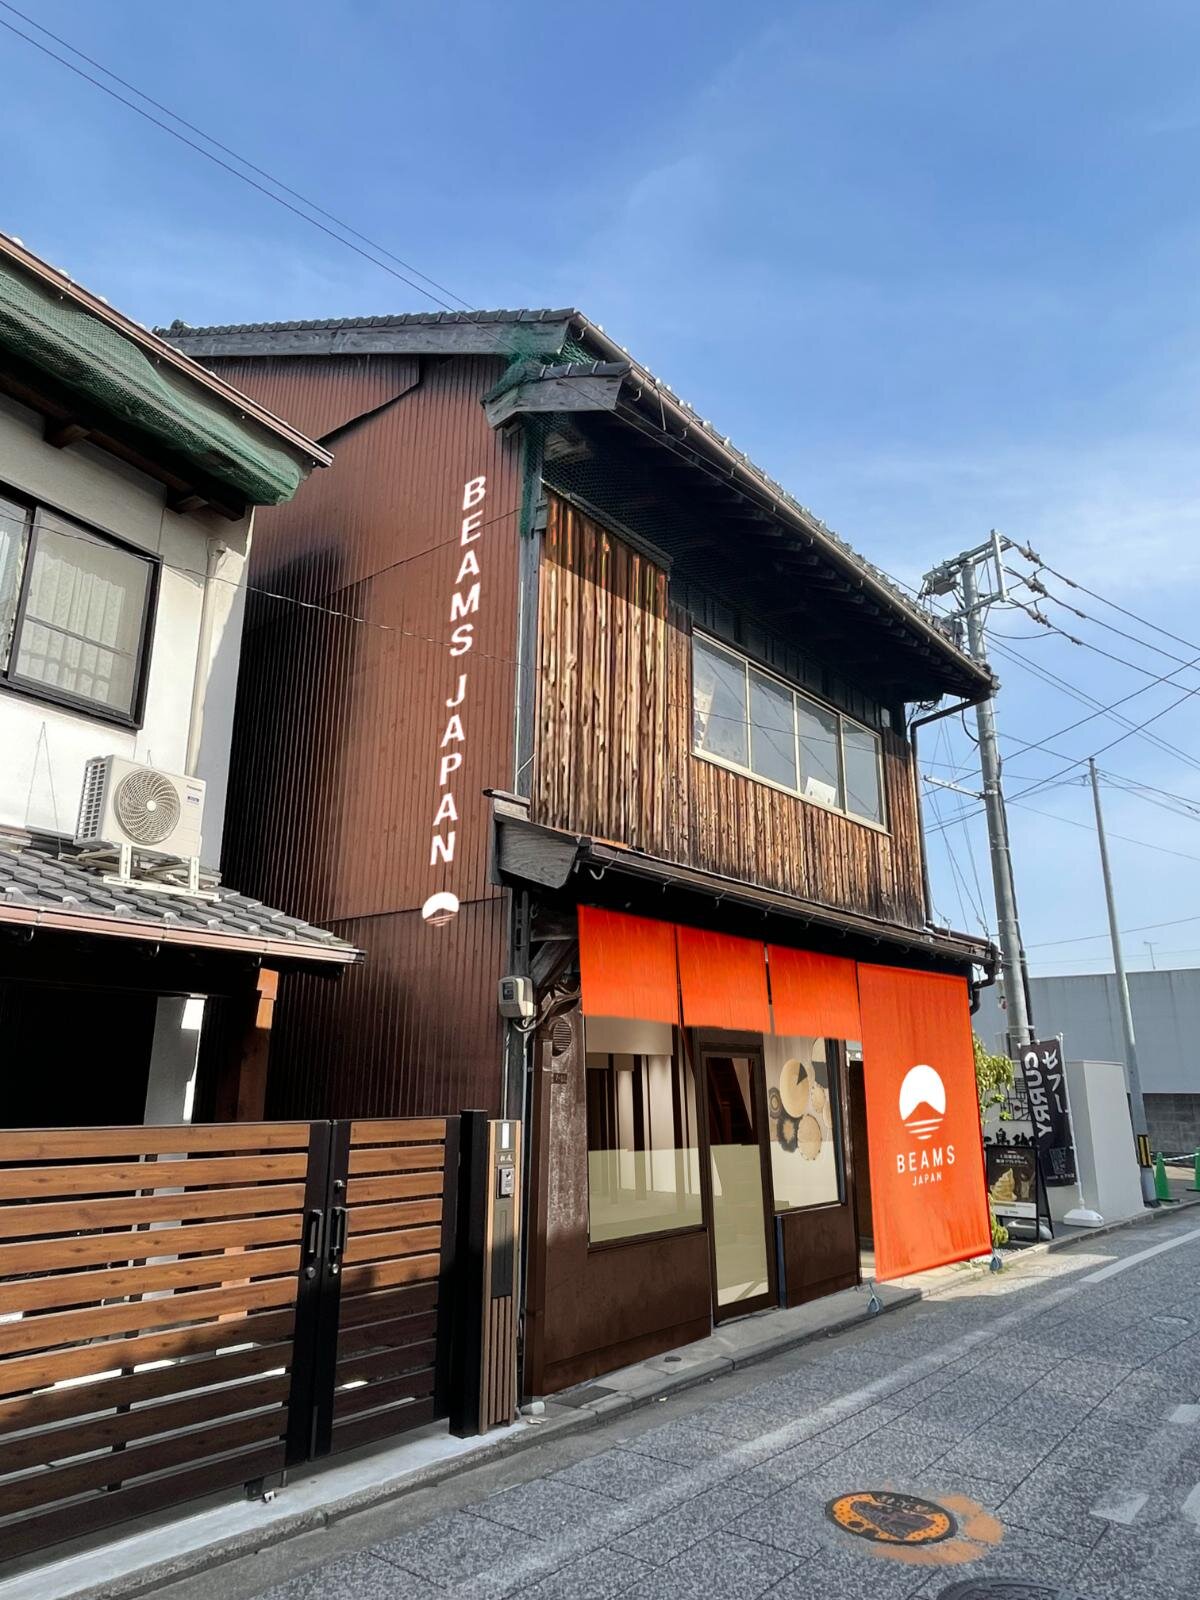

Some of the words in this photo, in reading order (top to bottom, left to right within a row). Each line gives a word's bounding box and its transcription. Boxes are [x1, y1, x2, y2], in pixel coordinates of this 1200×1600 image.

[449, 475, 486, 657] BEAMS
[430, 673, 467, 866] JAPAN
[896, 1144, 956, 1174] BEAMS
[912, 1171, 943, 1187] JAPAN
